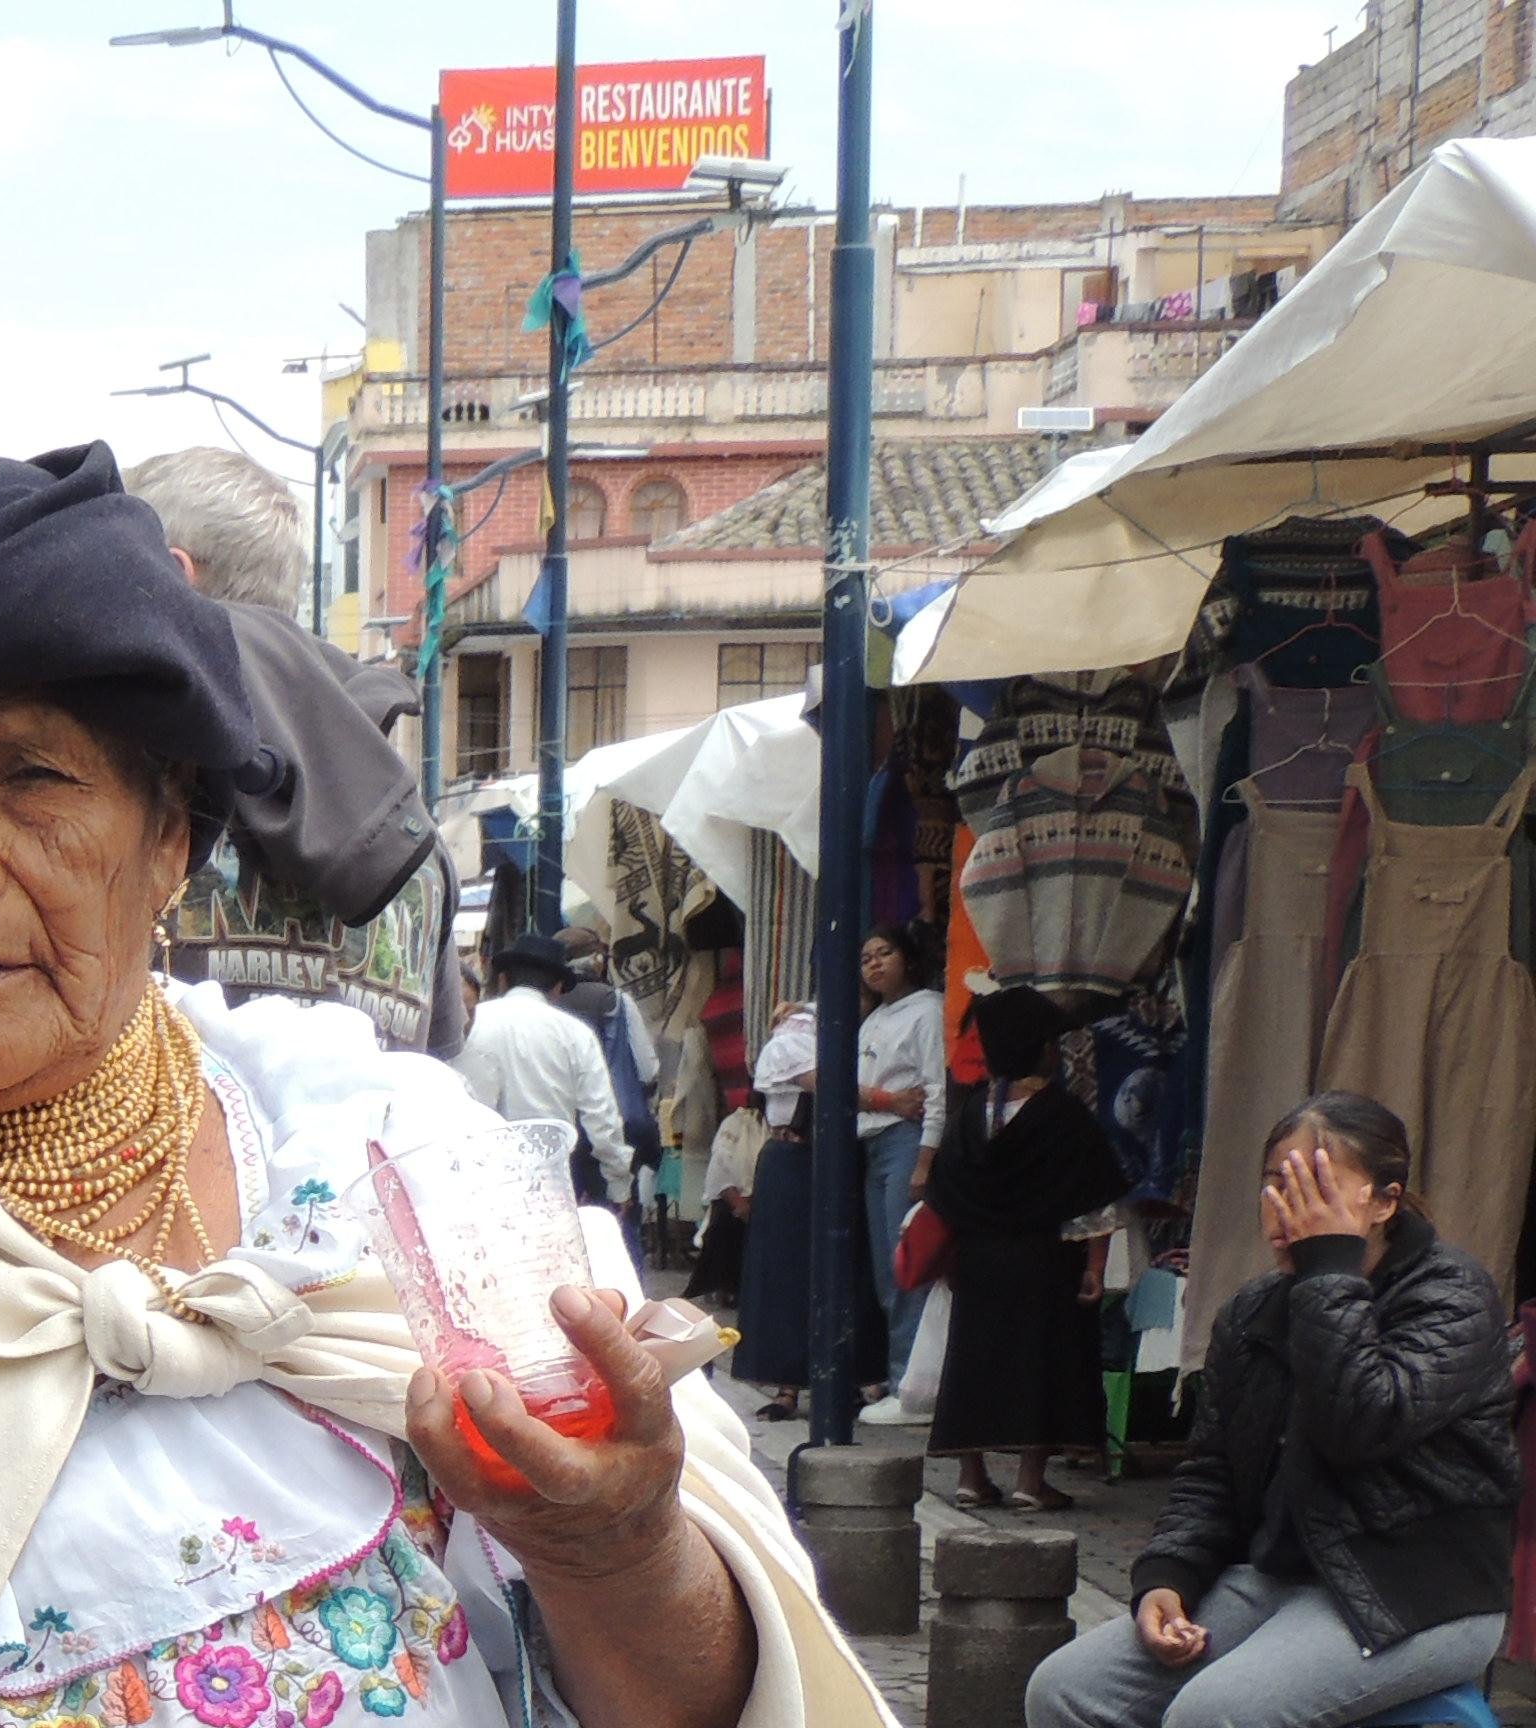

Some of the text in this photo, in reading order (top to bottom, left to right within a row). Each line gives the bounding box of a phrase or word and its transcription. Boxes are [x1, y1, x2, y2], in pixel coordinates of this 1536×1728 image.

[505, 104, 556, 129] INTY
[580, 77, 752, 124] RESTAURANTE
[580, 123, 749, 171] BIENVENIDOS
